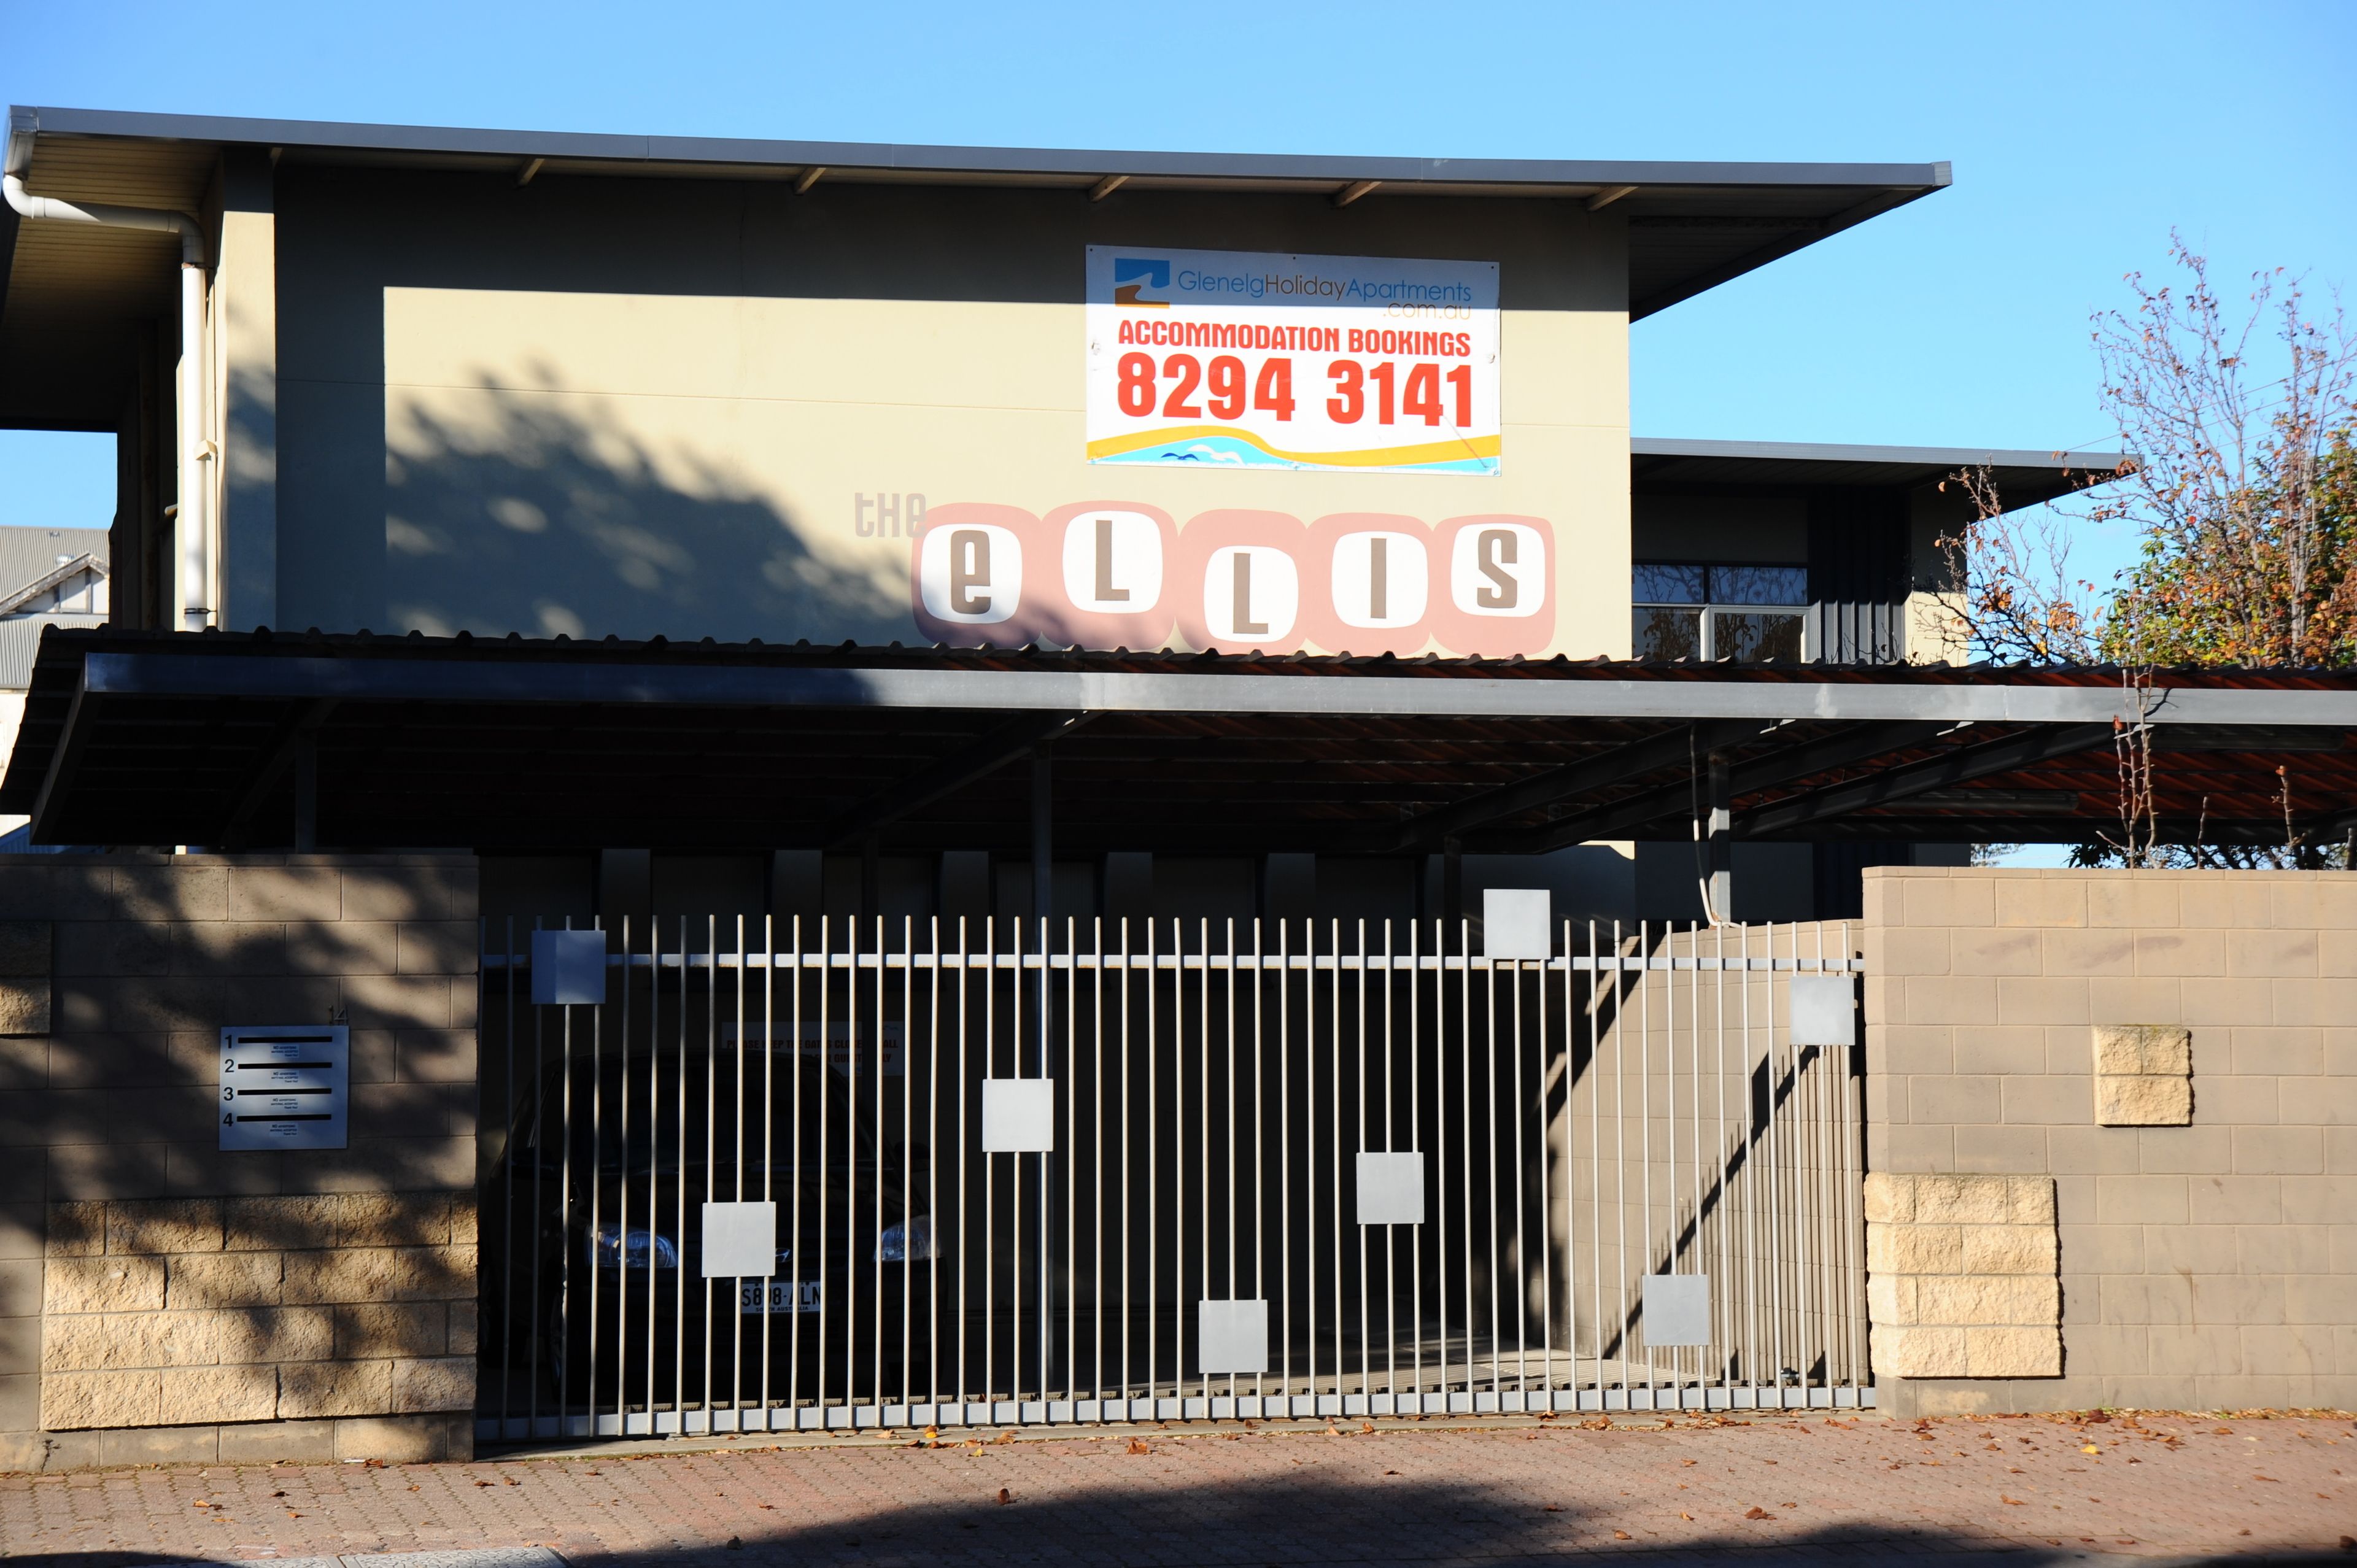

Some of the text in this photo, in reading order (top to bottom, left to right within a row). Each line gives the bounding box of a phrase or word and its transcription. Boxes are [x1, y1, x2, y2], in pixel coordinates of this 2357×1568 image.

[1178, 270, 1471, 302] GlenelgHolidayApartments
[1383, 302, 1471, 320] .com.au
[1118, 320, 1471, 357] ACCOMMODATION BOOKINGS
[1118, 352, 1471, 427] 8294 3141
[225, 1035, 232, 1049] 1
[727, 1040, 759, 1049] PLASE
[805, 1040, 832, 1049] GATS
[225, 1059, 234, 1073] 2
[223, 1087, 234, 1101] 3
[223, 1113, 233, 1127] 4
[741, 1286, 820, 1307] S88-LN
